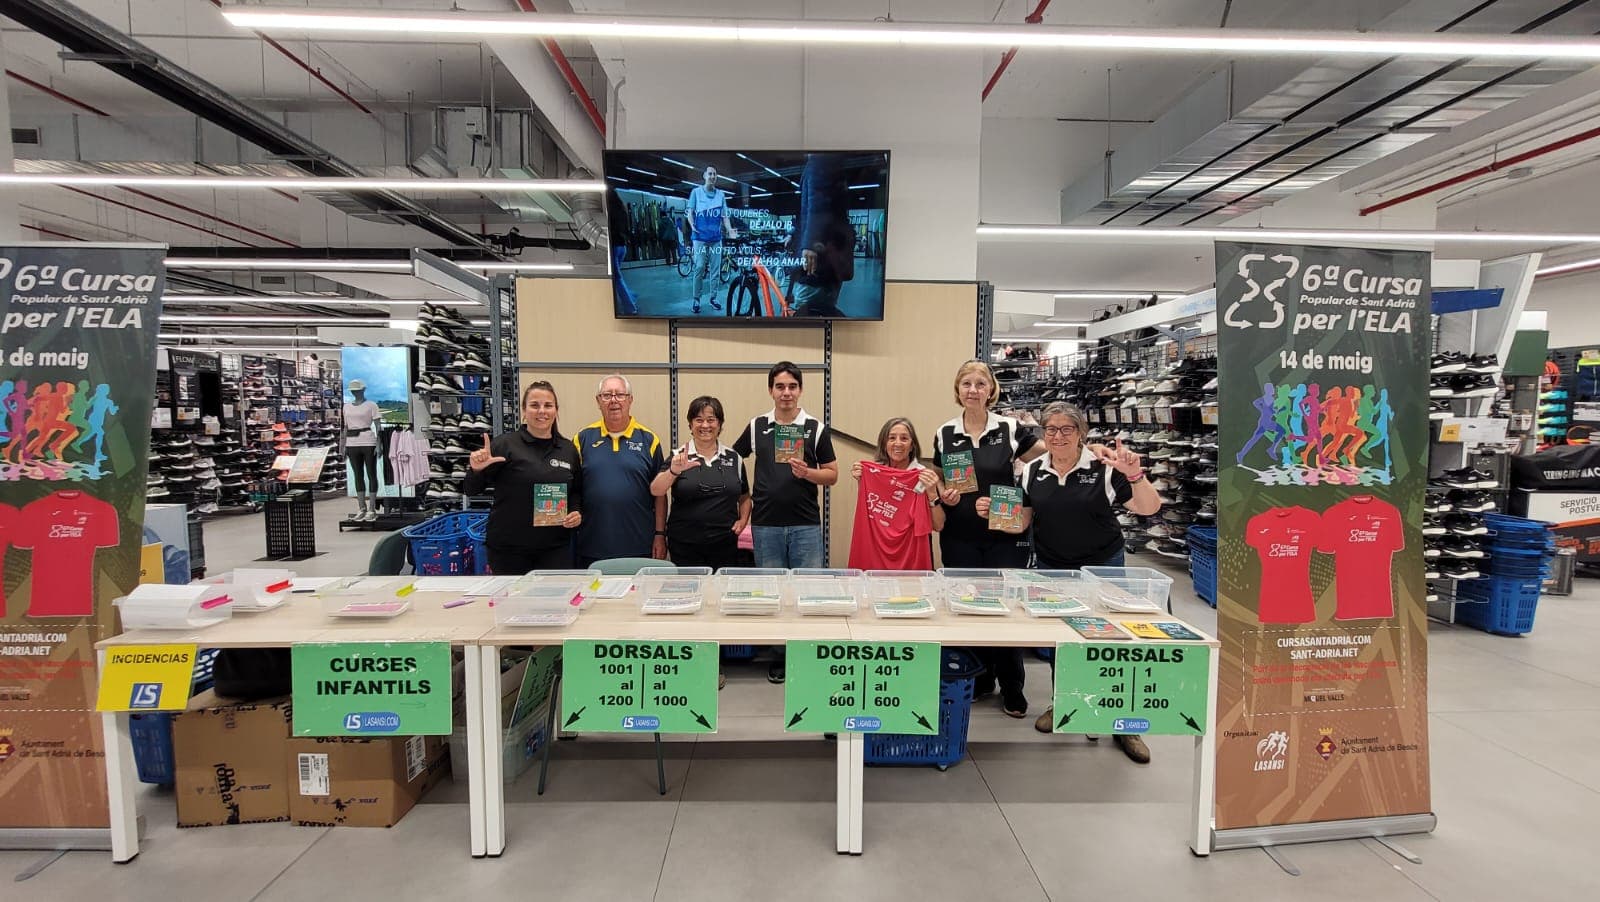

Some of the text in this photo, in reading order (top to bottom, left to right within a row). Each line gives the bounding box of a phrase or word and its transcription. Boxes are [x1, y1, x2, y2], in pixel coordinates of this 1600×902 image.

[706, 209, 719, 217] NO
[708, 246, 721, 254] NO
[61, 268, 156, 292] Cursa
[1343, 269, 1423, 296] Cursa
[11, 294, 148, 305] Popular de Sant Adrià
[1300, 295, 1416, 309] Popular de Sant Adrià
[2, 311, 57, 333] per
[1293, 313, 1342, 335] per
[10, 347, 33, 366] de
[39, 348, 89, 370] maig
[1280, 349, 1373, 374] 14 de maig
[1560, 497, 1597, 508] SERVICIO
[1277, 635, 1372, 648] CURSASANTADRIA.COM
[594, 644, 693, 660] DORSALS
[816, 645, 914, 661] DORSALS
[1086, 647, 1184, 663] DORSALS
[1290, 648, 1359, 660] SANT-ADRIA.NET
[112, 653, 189, 664] INCIDENCIAS
[330, 657, 417, 673] CURSES
[599, 664, 679, 675] 1001 801
[830, 665, 900, 676] 601 401
[1099, 667, 1152, 678] 201 1
[317, 680, 431, 695] INFANTILS
[620, 680, 666, 690] al al
[842, 681, 887, 691] al al
[1111, 683, 1156, 693] al al
[599, 695, 688, 706] 1200 1000
[829, 696, 900, 707] 800 600
[1098, 698, 1169, 709] 400 200
[364, 716, 399, 727] LASANSI.COM
[1254, 760, 1285, 771] LASANSI
